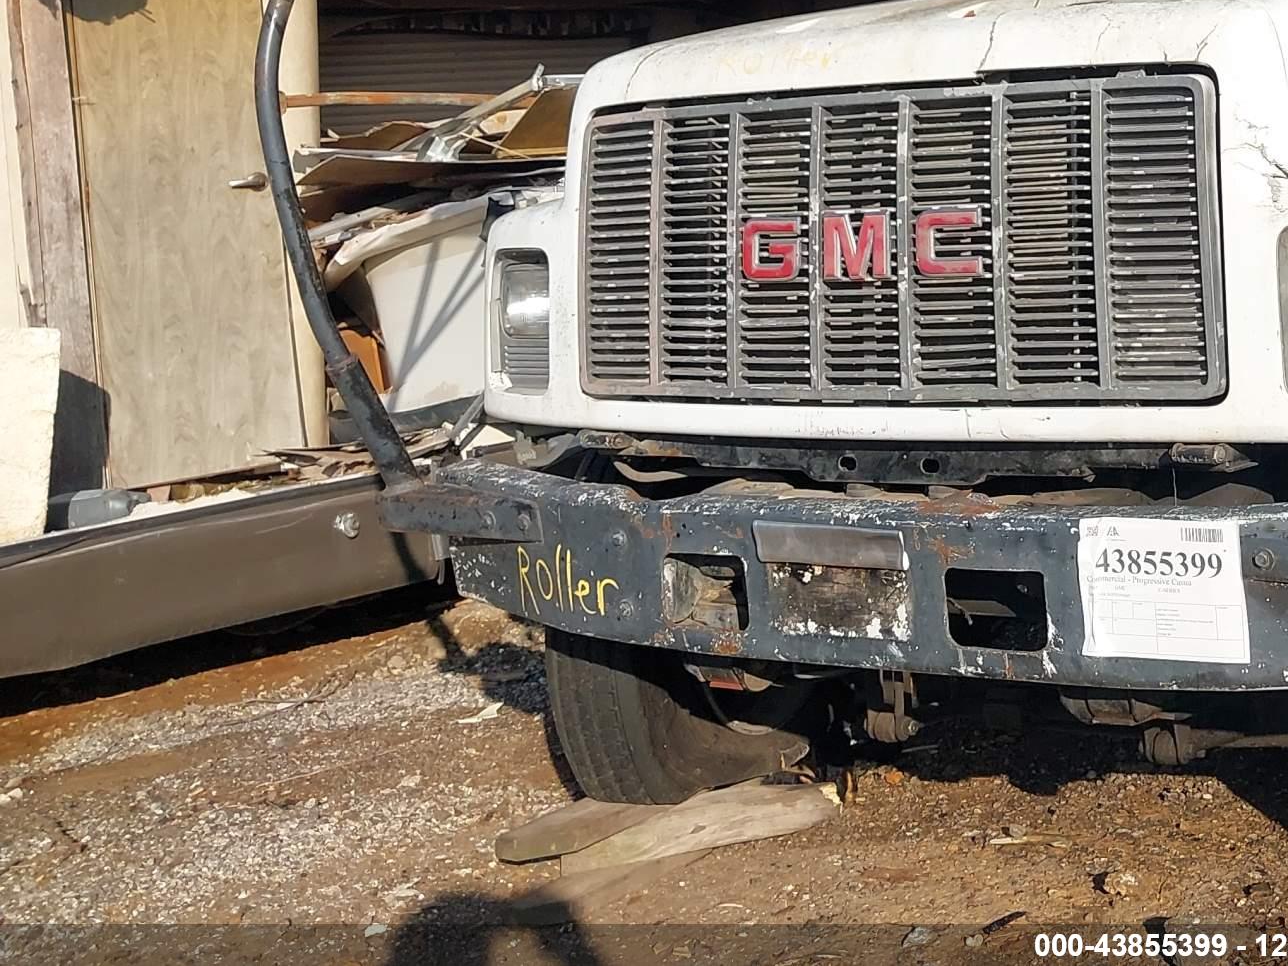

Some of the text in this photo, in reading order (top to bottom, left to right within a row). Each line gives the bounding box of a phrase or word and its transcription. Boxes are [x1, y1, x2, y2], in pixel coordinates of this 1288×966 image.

[743, 206, 983, 281] GMC
[518, 544, 619, 616] Roller
[1096, 548, 1222, 578] 43855399
[1132, 576, 1170, 585] Progressive
